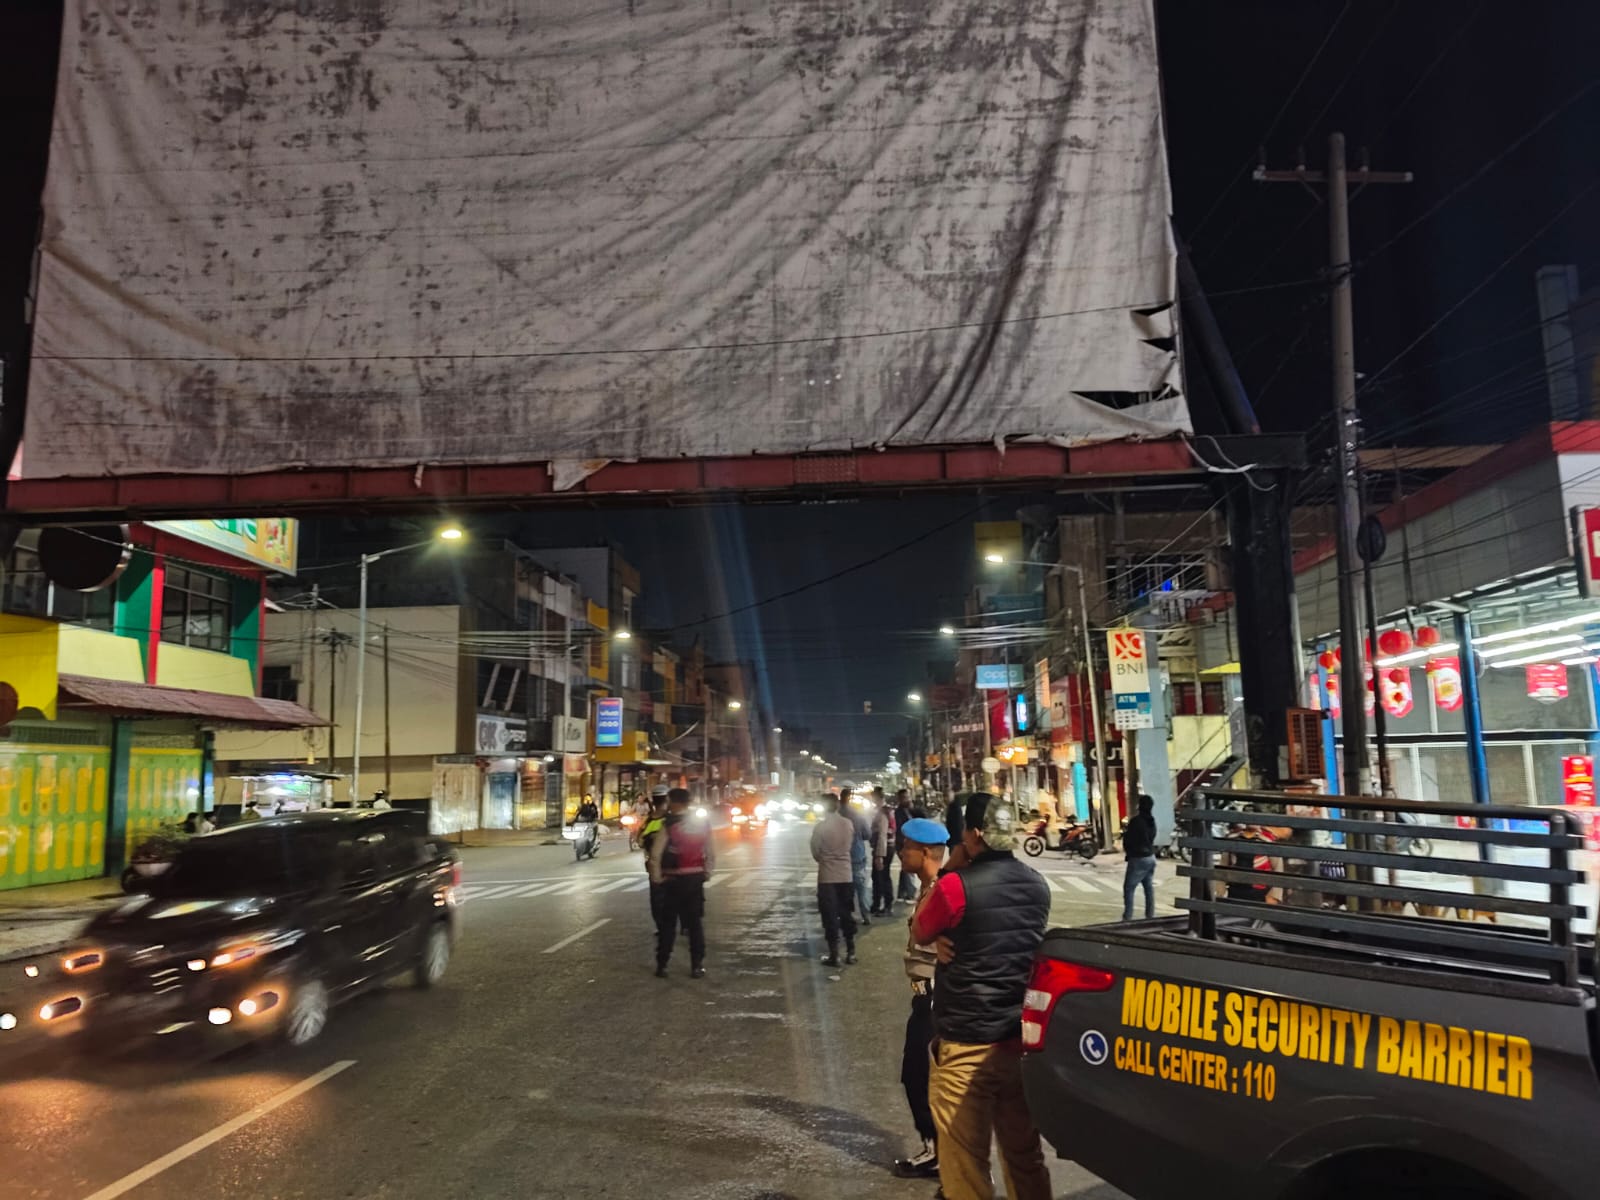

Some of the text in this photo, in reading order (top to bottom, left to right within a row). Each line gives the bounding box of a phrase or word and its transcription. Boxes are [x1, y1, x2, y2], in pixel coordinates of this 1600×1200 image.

[1116, 663, 1145, 676] BNI
[1117, 695, 1138, 704] ATM
[1121, 977, 1534, 1100] MOBILE SECURITY BARRIER
[1114, 1036, 1155, 1075] CALL
[1158, 1044, 1228, 1092] CENTER
[1243, 1060, 1276, 1101] 110
